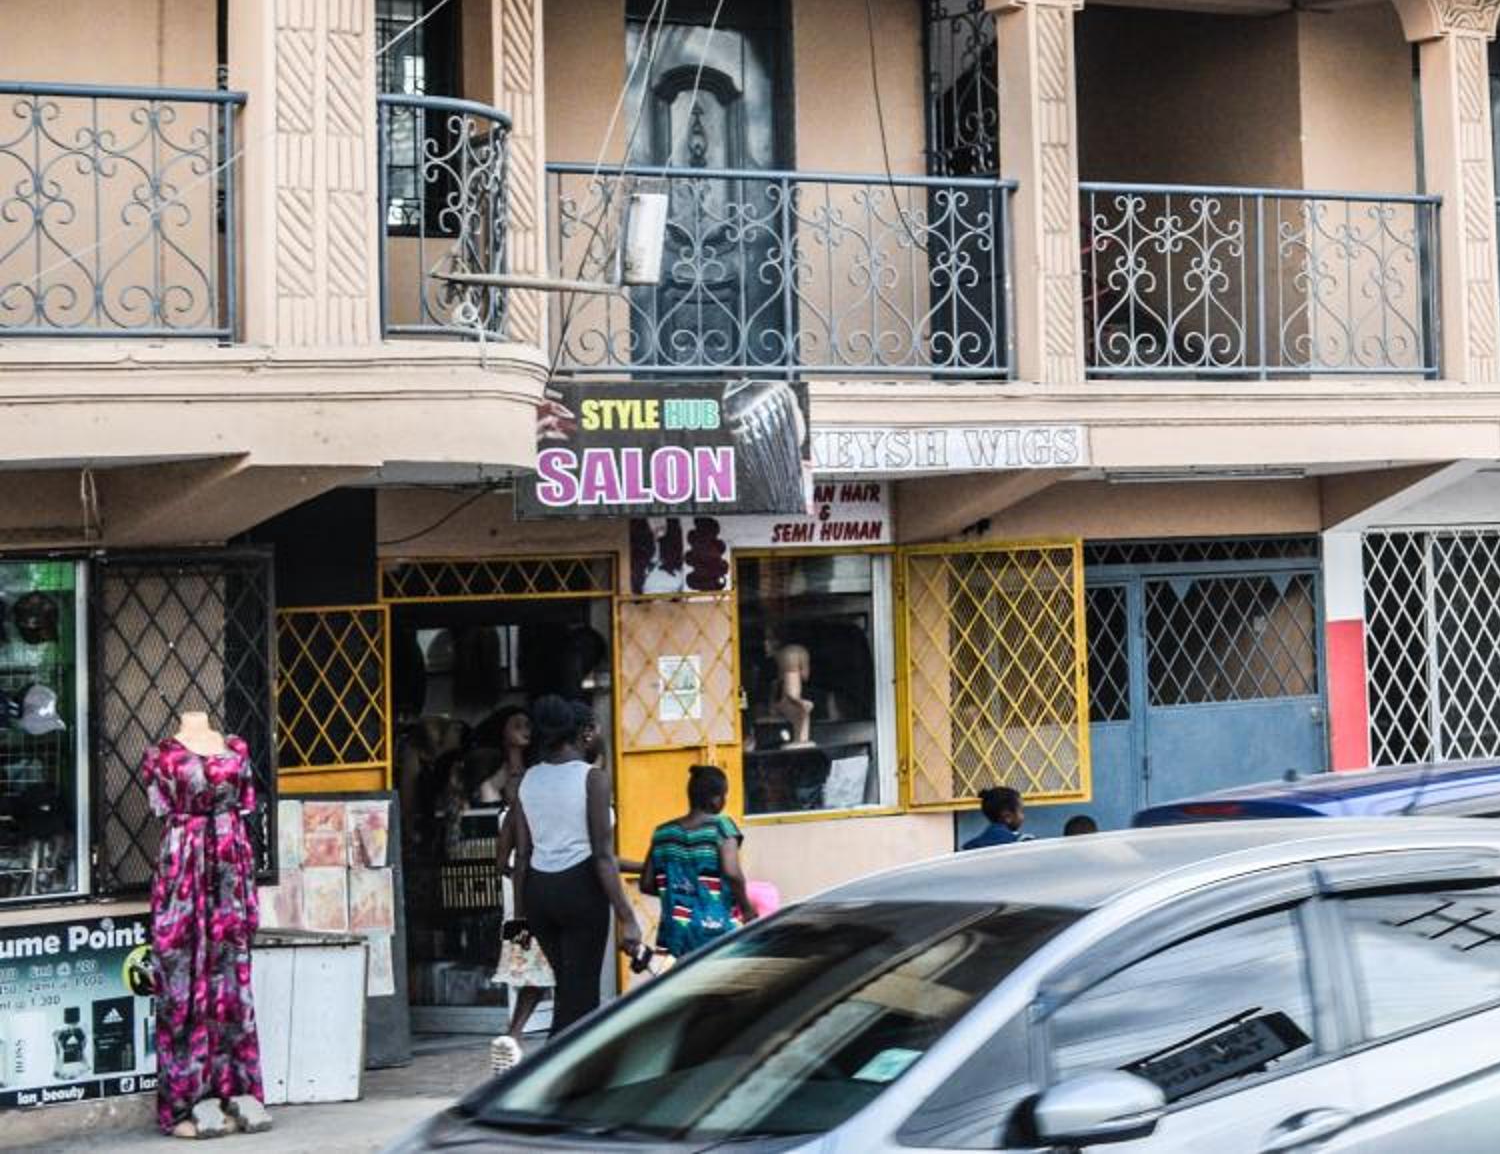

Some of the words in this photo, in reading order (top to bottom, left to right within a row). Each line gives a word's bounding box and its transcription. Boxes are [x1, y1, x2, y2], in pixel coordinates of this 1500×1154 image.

[581, 399, 661, 430] STYLE
[663, 398, 720, 430] HUB
[963, 429, 1079, 467] WIGS
[536, 446, 736, 506] SALON
[840, 484, 881, 503] HAIR
[819, 504, 831, 521] &
[771, 523, 815, 543] SEMI
[819, 521, 883, 541] HUMAN
[0, 934, 61, 958] ume
[68, 919, 147, 952] Point
